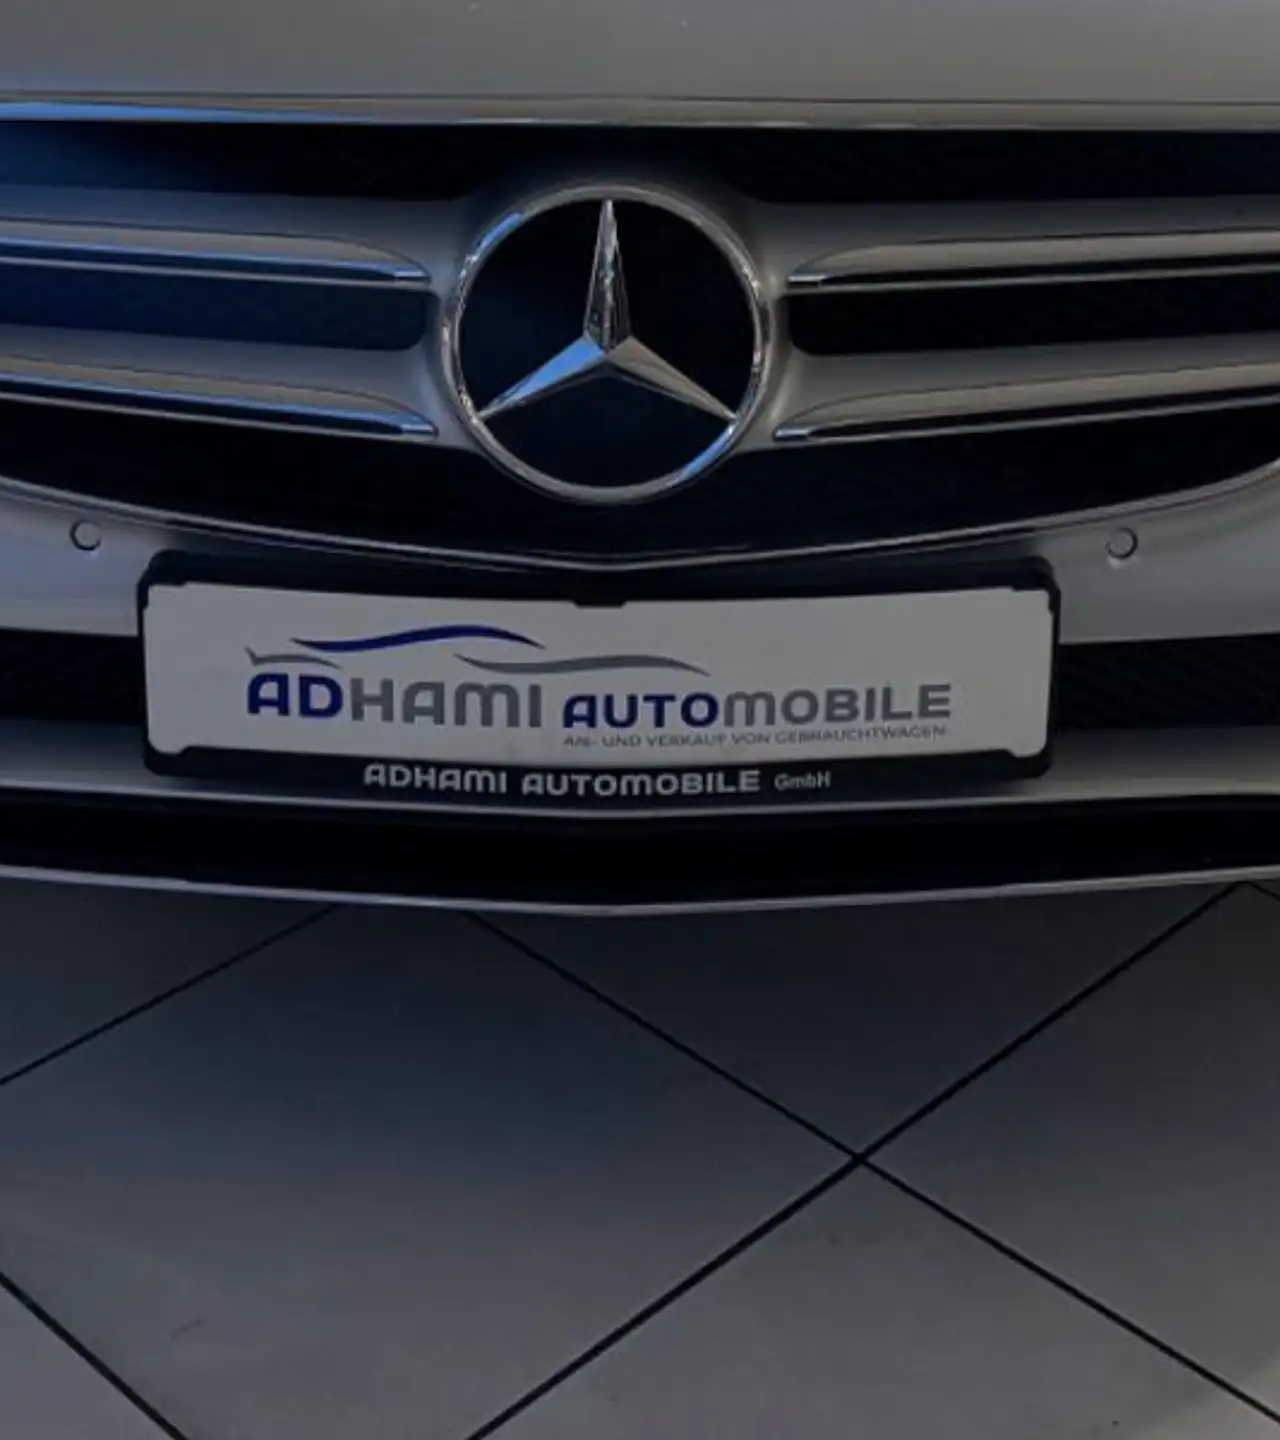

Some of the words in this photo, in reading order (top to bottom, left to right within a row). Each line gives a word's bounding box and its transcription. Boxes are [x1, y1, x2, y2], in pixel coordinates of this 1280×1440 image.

[247, 672, 542, 728] ADHAMI
[562, 683, 952, 729] AUTOMOBILE
[602, 736, 642, 748] UND
[647, 734, 728, 748] VERKAUF
[731, 733, 770, 745] VON
[775, 725, 947, 745] GEBRAUCHTWAGEN
[363, 762, 508, 794] ADHAMI
[521, 770, 761, 797] AUTOMOBILE
[774, 770, 832, 793] GmbH
